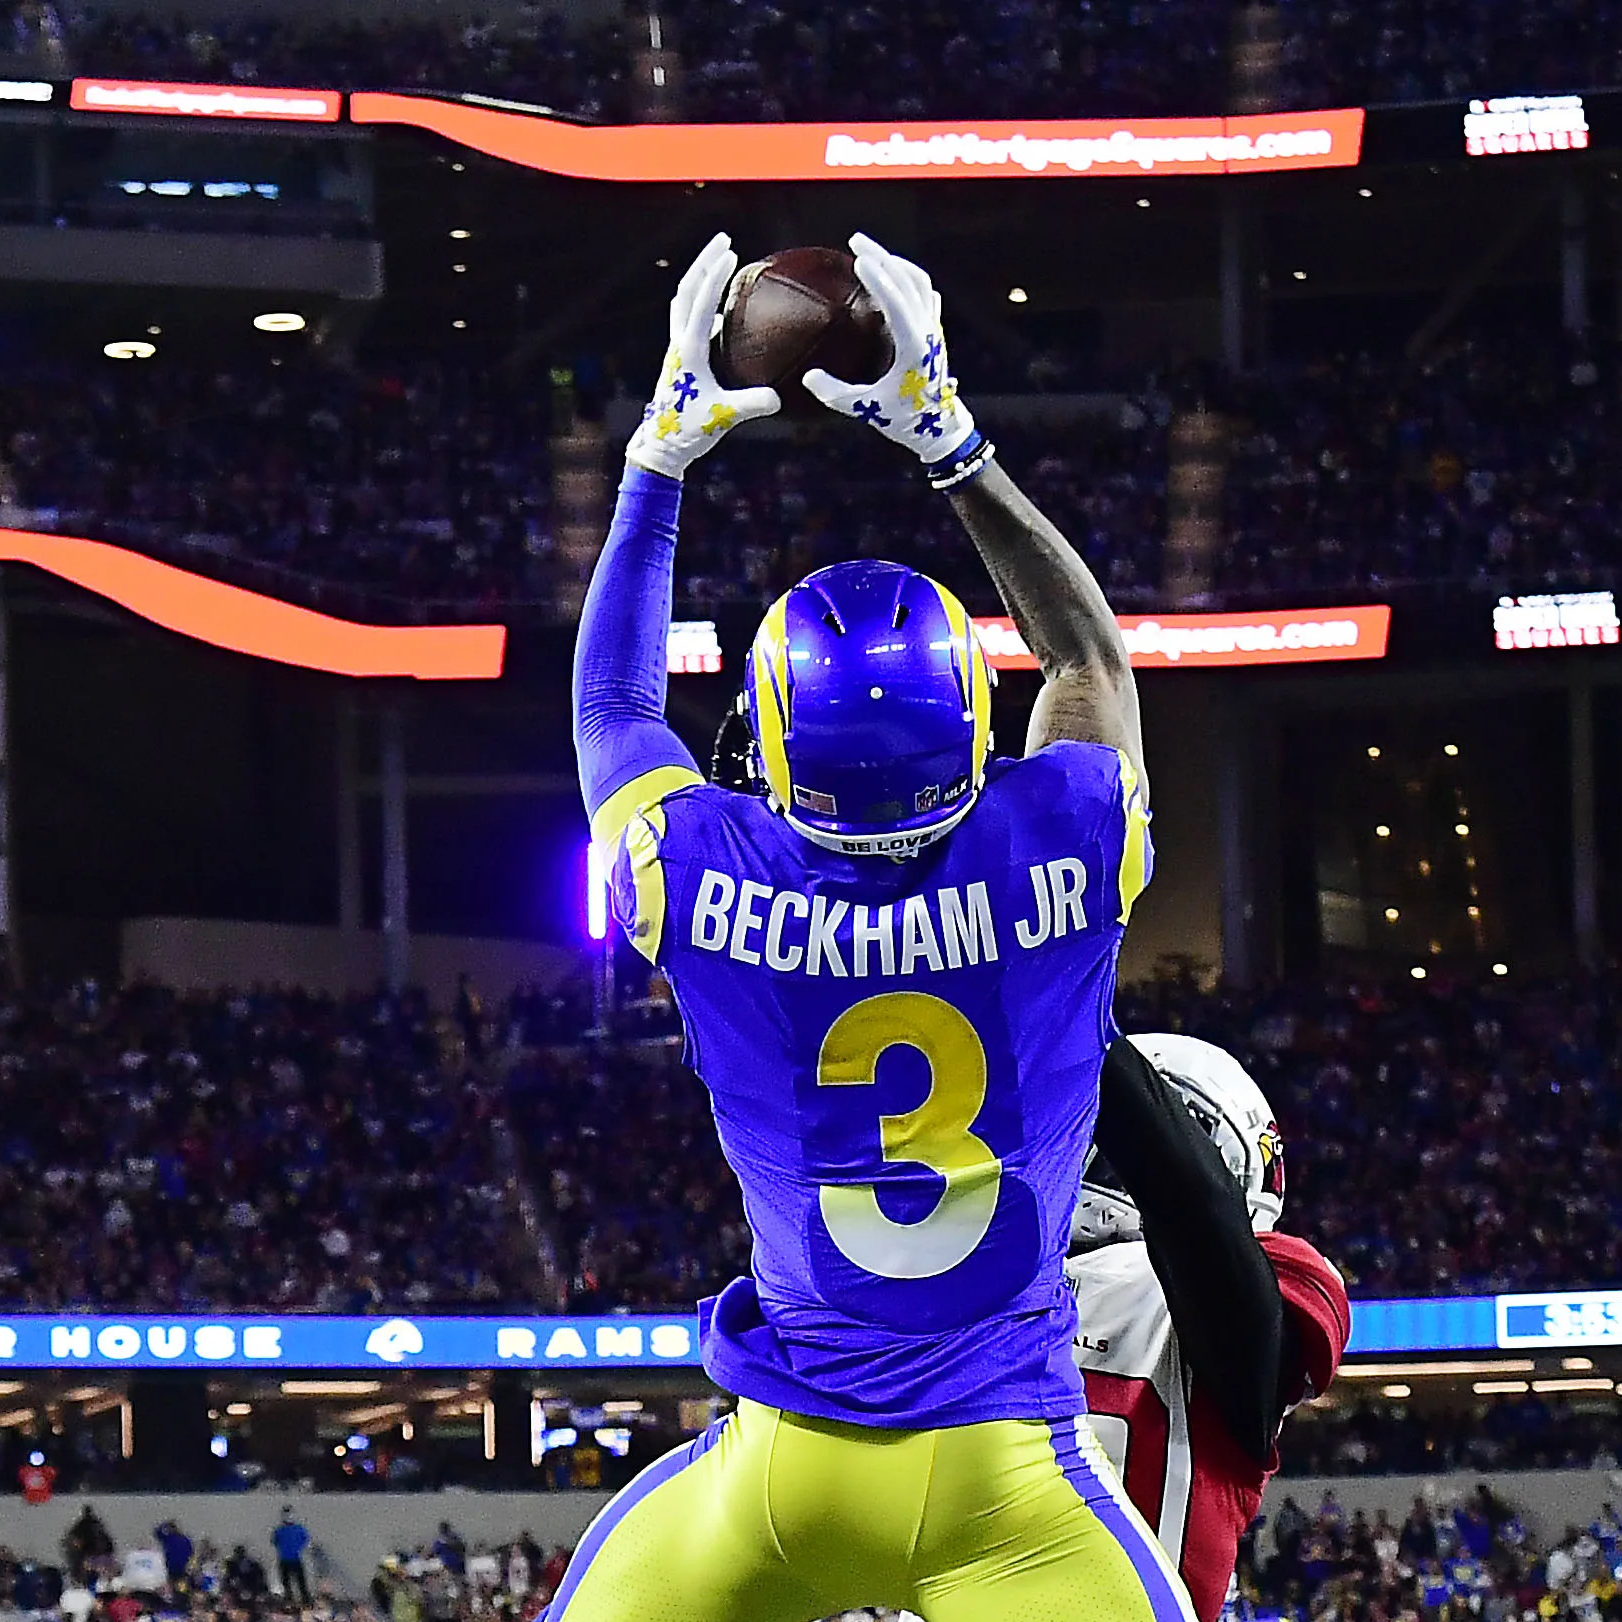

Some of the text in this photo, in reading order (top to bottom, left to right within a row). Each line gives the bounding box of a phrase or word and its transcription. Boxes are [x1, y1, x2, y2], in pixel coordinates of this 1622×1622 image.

[943, 779, 968, 803] MLK
[841, 841, 871, 852] BE
[691, 857, 1088, 978] BECKHAM JR
[816, 990, 1003, 1279] 3
[51, 1324, 282, 1358] HOUSE
[497, 1325, 691, 1359] RAMS
